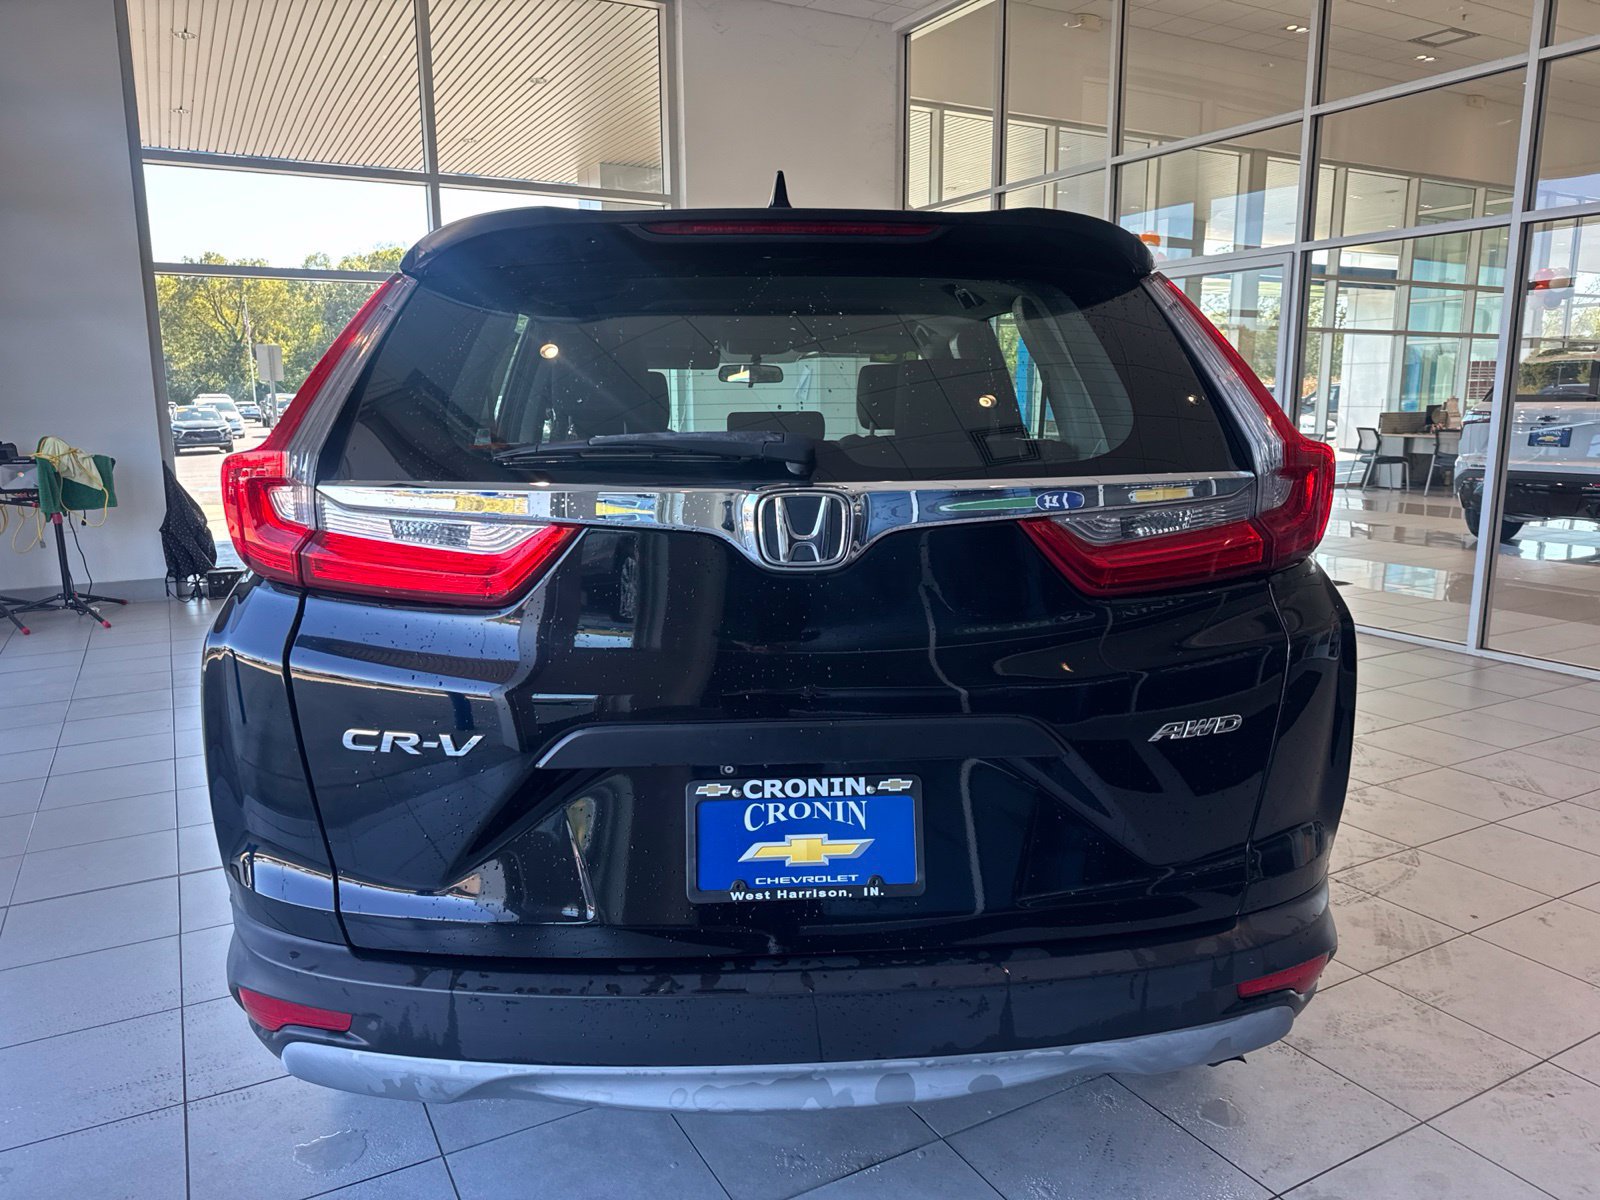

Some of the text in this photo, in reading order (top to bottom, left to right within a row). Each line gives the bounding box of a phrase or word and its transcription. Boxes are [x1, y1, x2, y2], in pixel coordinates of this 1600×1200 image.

[1148, 714, 1242, 742] AWD
[342, 728, 485, 757] CR-V
[743, 777, 866, 799] CRONIN
[744, 801, 868, 832] CRONIN
[755, 875, 859, 885] CHEVROLET
[731, 887, 885, 901] West Harrison, IN.
